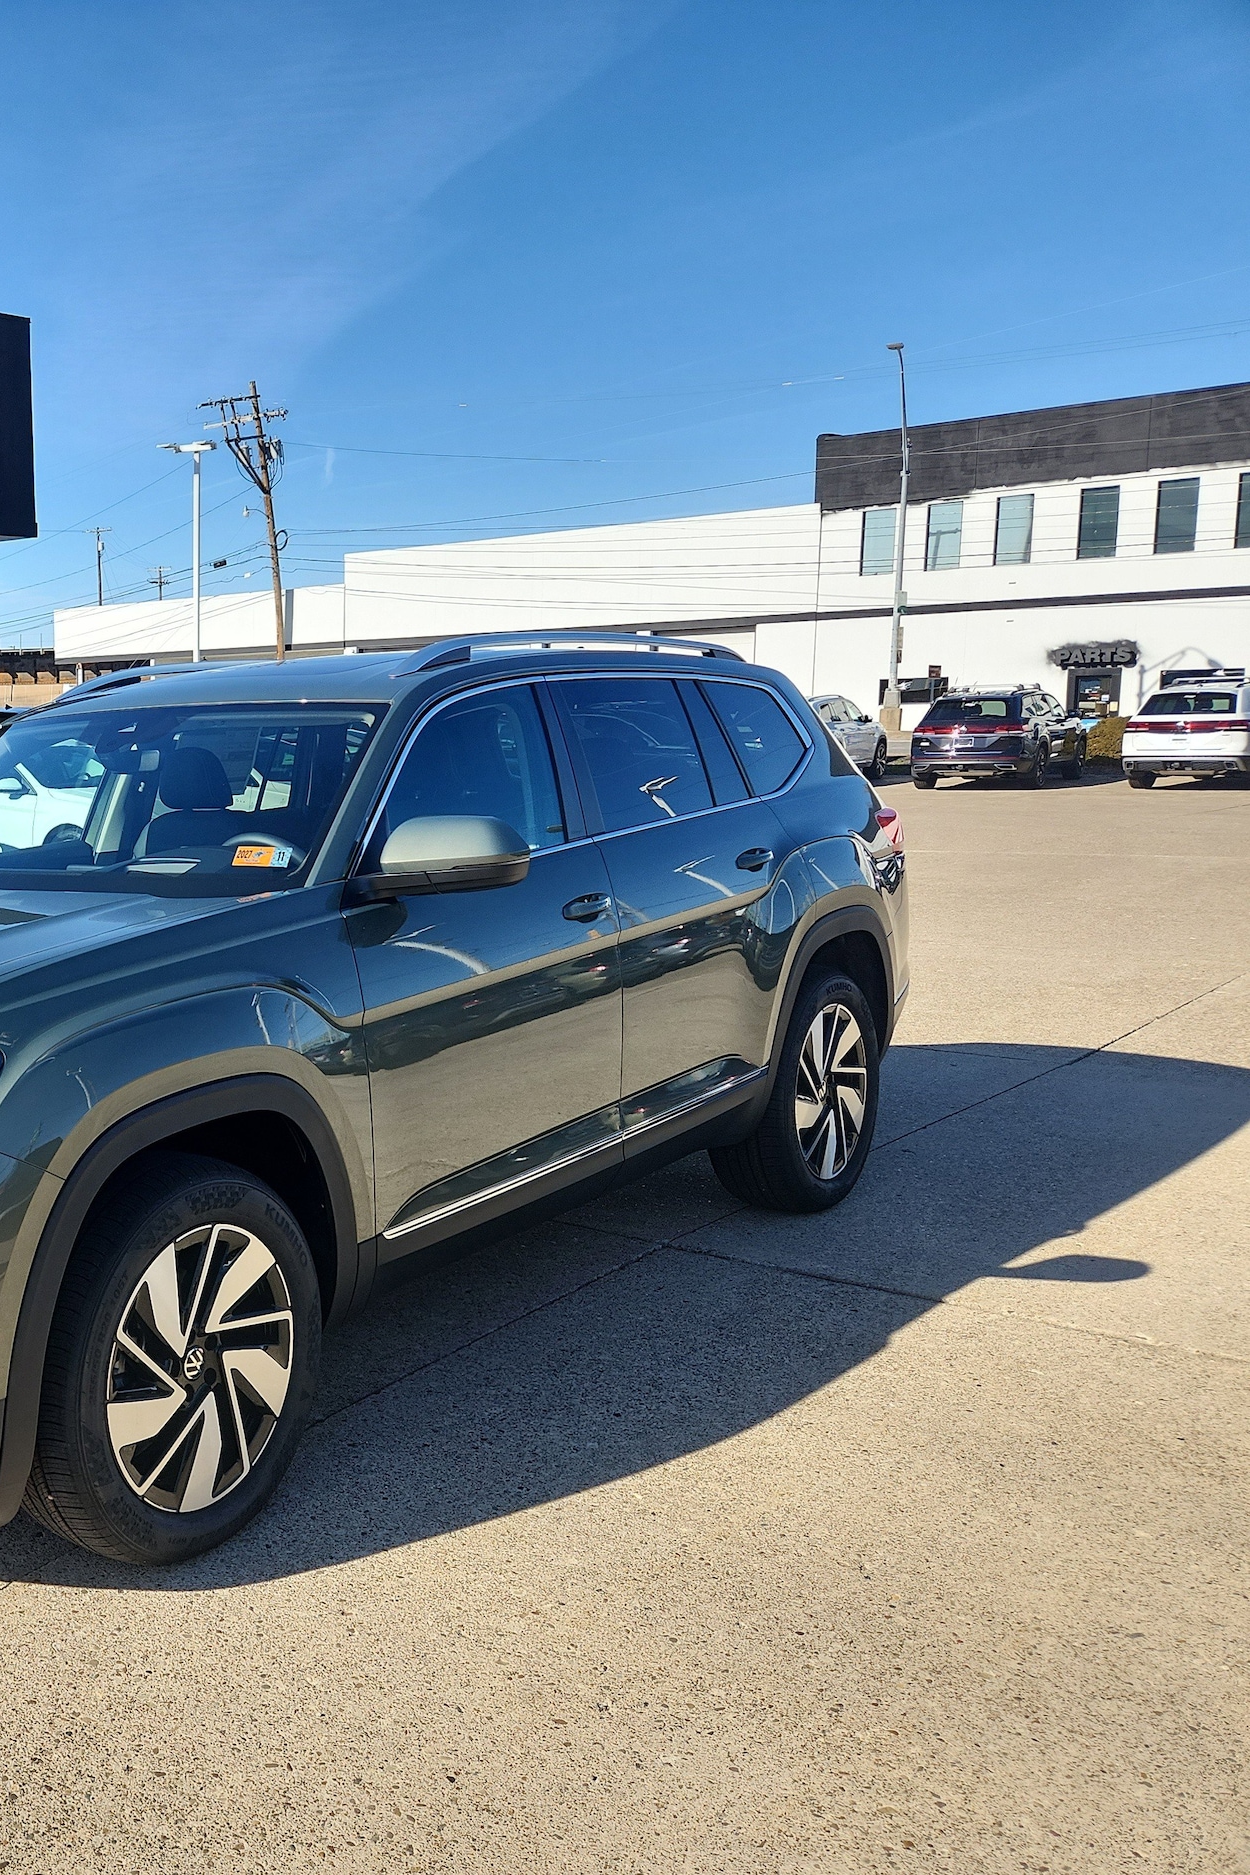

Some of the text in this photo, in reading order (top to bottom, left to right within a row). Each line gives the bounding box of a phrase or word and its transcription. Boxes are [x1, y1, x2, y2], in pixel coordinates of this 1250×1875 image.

[1054, 646, 1132, 664] PARTS
[236, 849, 286, 862] 2027 11
